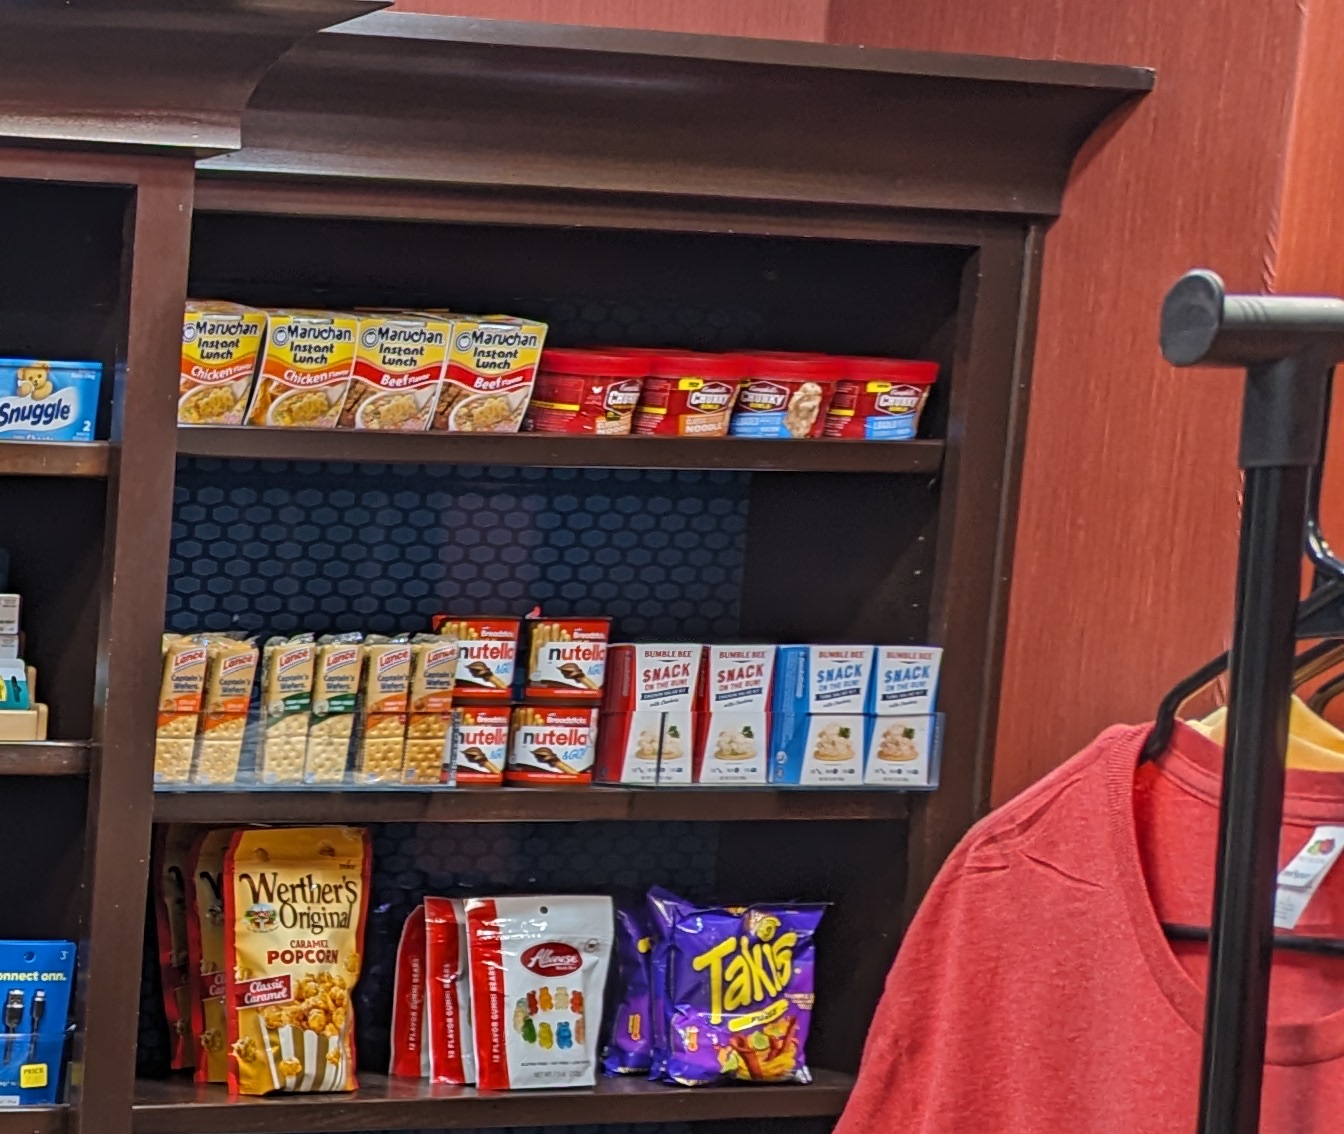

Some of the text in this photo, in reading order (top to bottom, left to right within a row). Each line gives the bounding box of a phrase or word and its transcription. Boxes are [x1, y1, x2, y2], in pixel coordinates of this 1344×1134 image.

[196, 321, 258, 336] Maruchan
[287, 324, 352, 341] Maruchan
[377, 326, 444, 344] Maruchan
[198, 338, 241, 349] Instant
[472, 330, 538, 347] Maruchan
[200, 350, 233, 360] Lunch
[290, 341, 335, 354] Instant
[379, 343, 425, 357] Instant
[473, 346, 519, 360] Instant
[293, 354, 328, 365] Lunch
[382, 355, 418, 367] Lunch
[475, 359, 512, 370] Lunch
[191, 365, 233, 380] Chicken
[284, 369, 328, 384] Chicken
[380, 373, 410, 388] Beef
[474, 376, 502, 389] Beef
[82, 420, 92, 432] 2
[175, 650, 205, 667] Lance
[279, 649, 310, 667] Lance
[327, 650, 356, 667] Lance
[379, 650, 410, 668] Lance
[427, 647, 457, 665] Lance
[644, 650, 693, 658] BUMBLE BEE
[223, 655, 253, 671] Lance
[642, 662, 692, 684] SNACK
[717, 662, 765, 684] SNACK
[816, 663, 863, 684] SNACK
[884, 664, 931, 684] SNACK
[523, 729, 588, 746] nutella
[238, 871, 358, 904] Werther's
[279, 901, 353, 935] Original
[289, 939, 330, 949] CARAMEL
[267, 949, 339, 965] POPCORN
[40, 972, 68, 982] onn.
[692, 917, 798, 1026] Takis
[249, 978, 285, 994] Classic
[244, 989, 289, 1005] Caramel
[23, 1067, 44, 1075] PRICE
